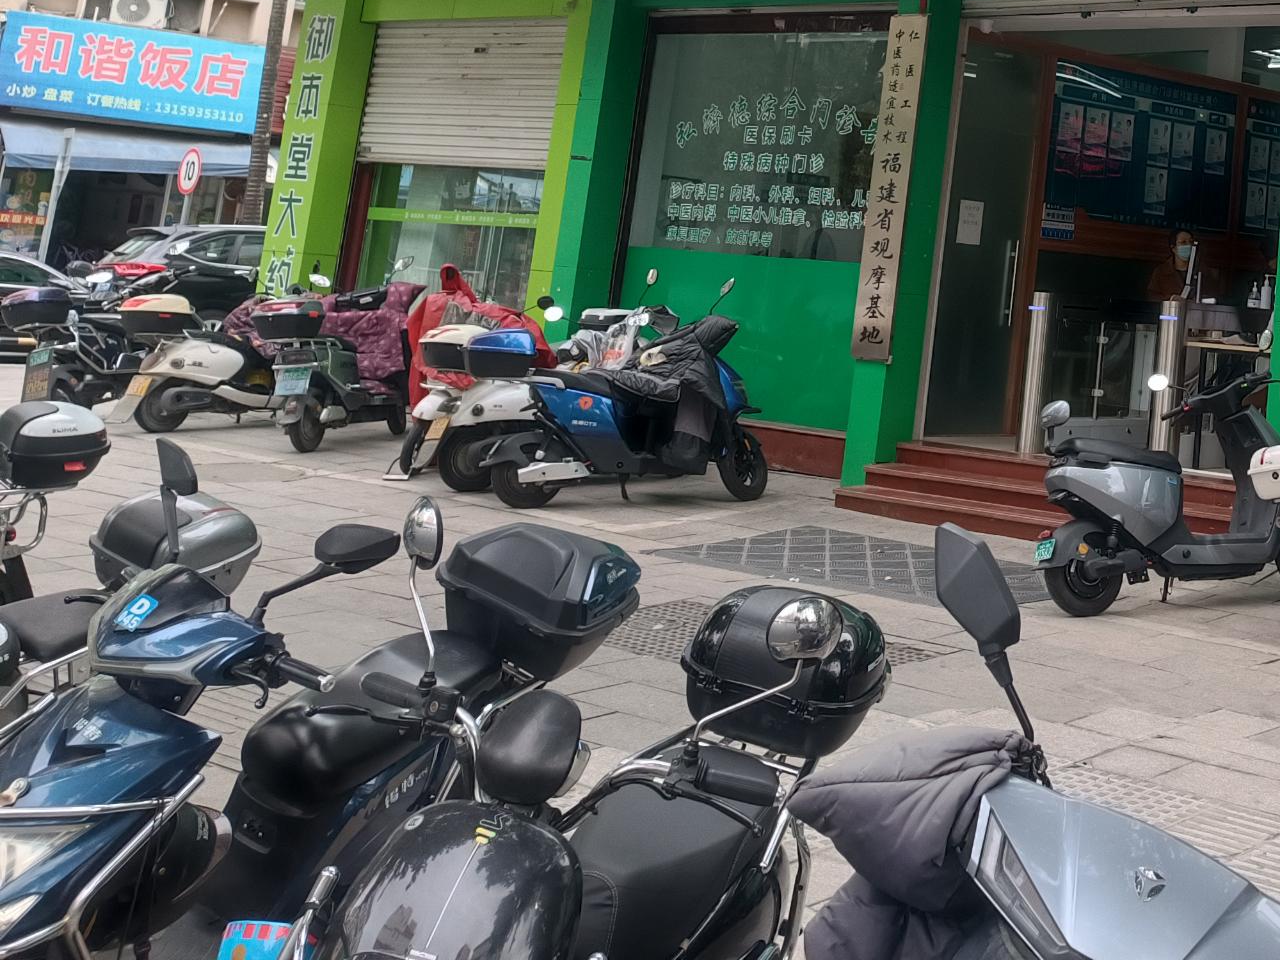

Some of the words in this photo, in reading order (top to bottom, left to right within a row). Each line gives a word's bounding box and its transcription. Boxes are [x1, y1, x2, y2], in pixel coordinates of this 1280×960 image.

[15, 25, 248, 99] 和谐饭店
[6, 84, 37, 98] 小炒
[744, 125, 813, 145] 医保刷卡
[185, 160, 195, 181] 10
[723, 151, 825, 174] 特殊病种门诊
[858, 152, 902, 345] 福建省观摩基地
[130, 597, 151, 615] D
